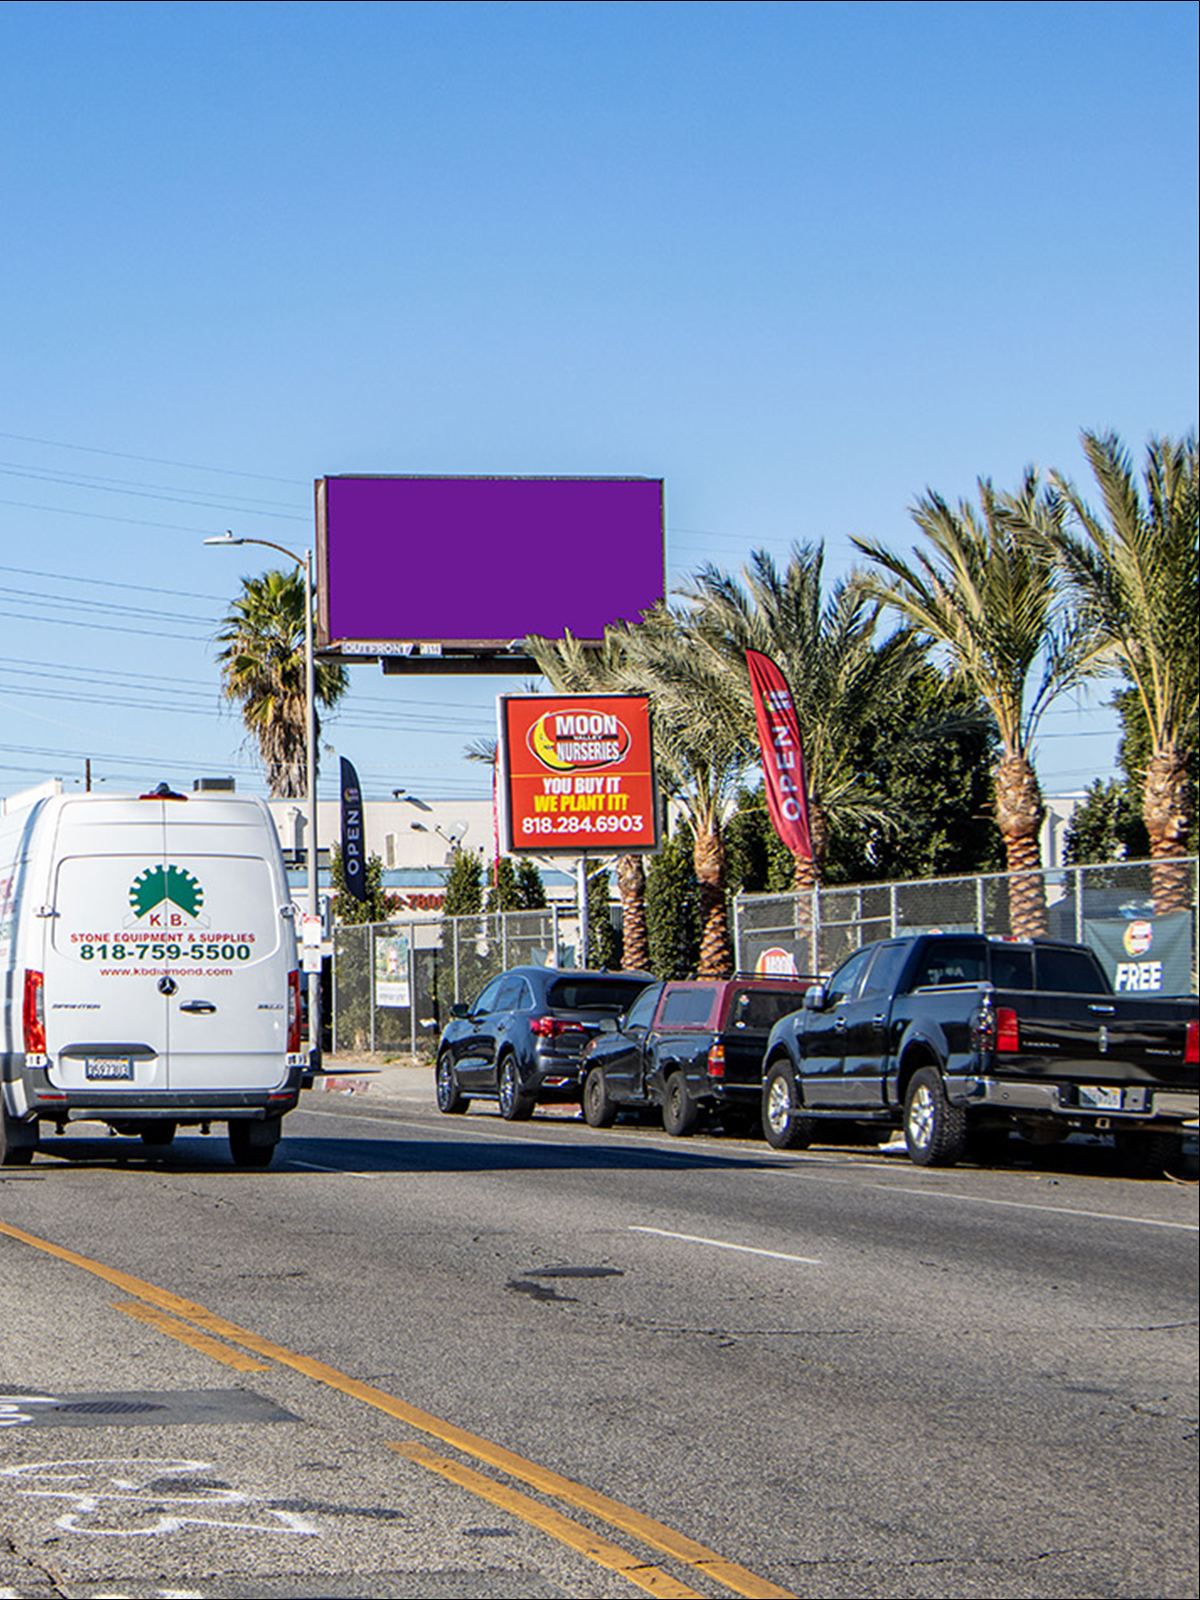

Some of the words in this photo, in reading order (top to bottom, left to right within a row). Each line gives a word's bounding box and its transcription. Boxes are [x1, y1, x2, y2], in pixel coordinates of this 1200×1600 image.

[555, 715, 618, 735] MOON
[556, 741, 621, 762] NURSERIES
[772, 724, 801, 822] OPEN
[542, 777, 572, 795] YOU
[574, 777, 604, 794] BUY
[606, 777, 622, 794] IT
[534, 795, 559, 812] WE
[560, 794, 605, 812] PLANT
[607, 794, 628, 811] IT!
[522, 815, 644, 834] 818.284.6903
[347, 810, 360, 876] OPEN
[71, 933, 110, 944] STONE
[114, 933, 184, 944] EQUIPMENT
[187, 933, 196, 943] &
[200, 932, 256, 943] SUPPLIES
[80, 944, 251, 960] 818-759-5500
[100, 967, 233, 977] www.kbdiamond.com
[1115, 961, 1163, 992] FREE
